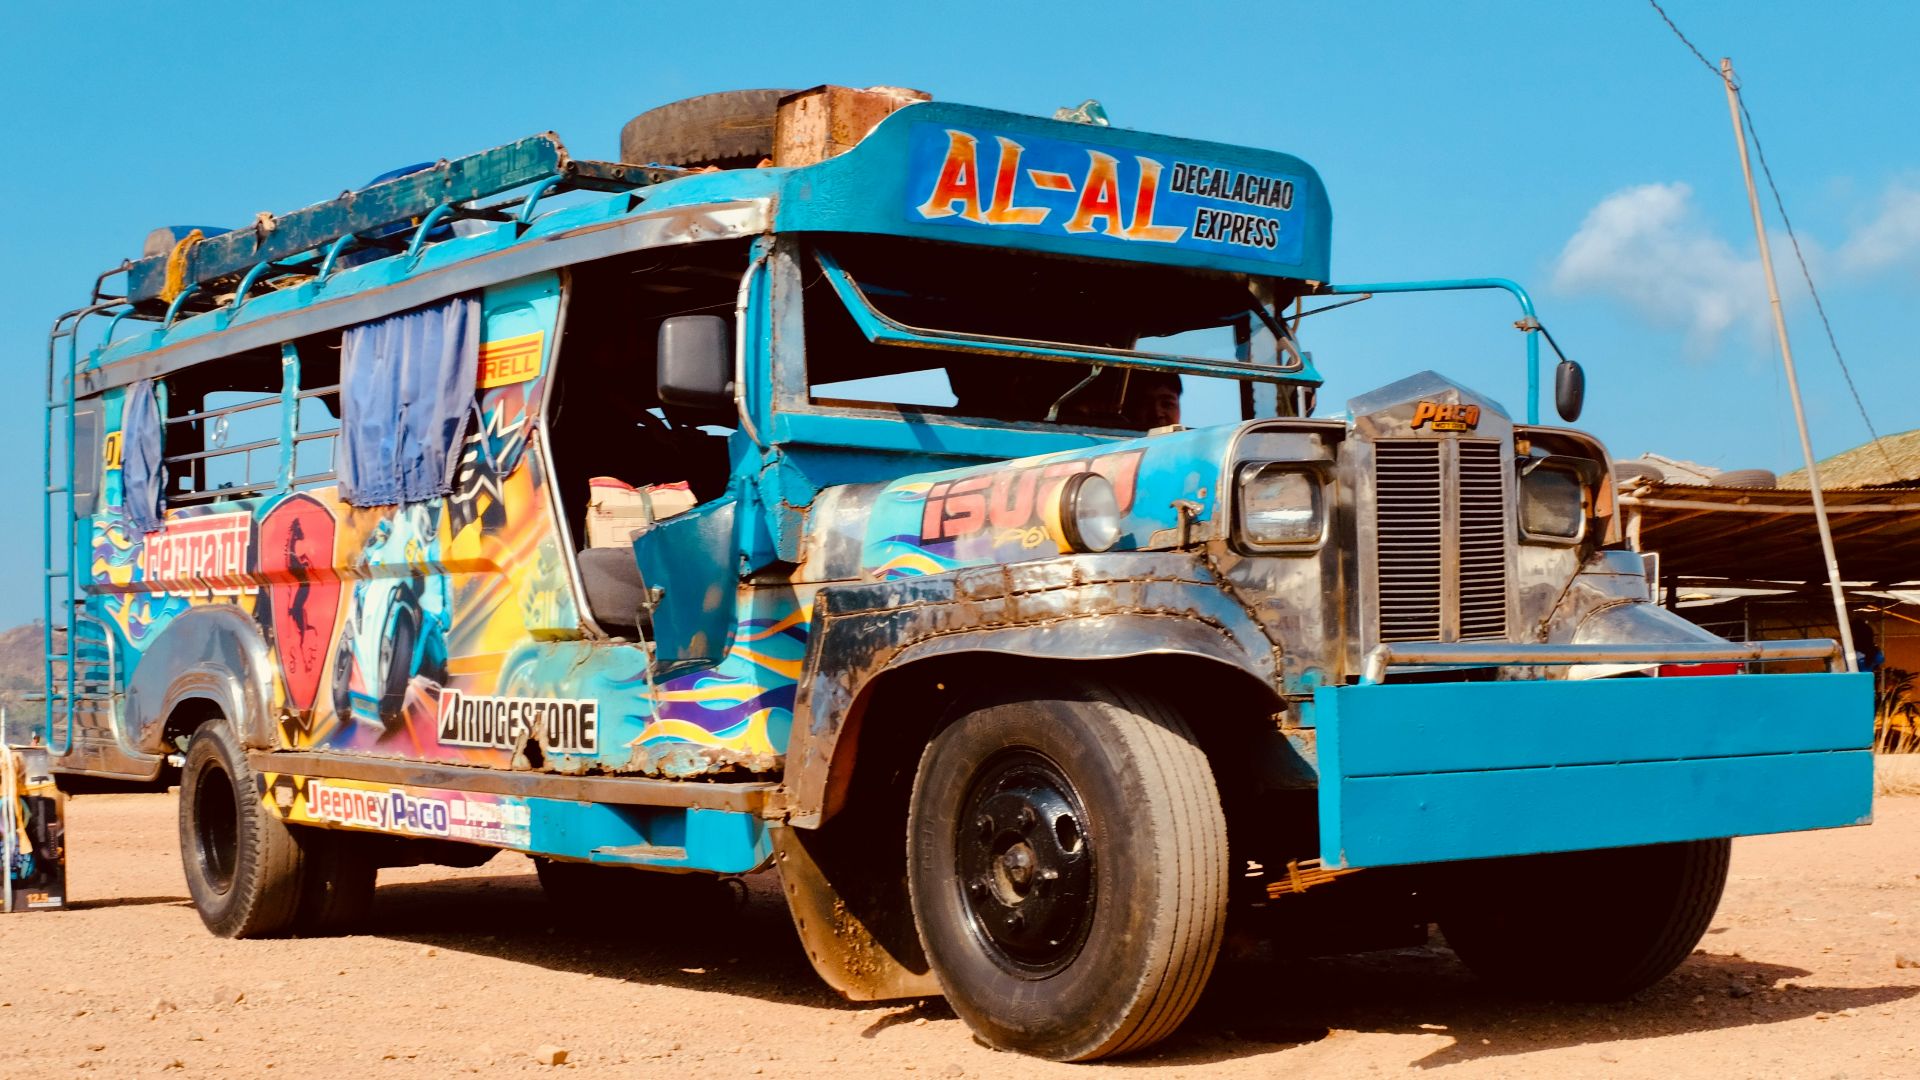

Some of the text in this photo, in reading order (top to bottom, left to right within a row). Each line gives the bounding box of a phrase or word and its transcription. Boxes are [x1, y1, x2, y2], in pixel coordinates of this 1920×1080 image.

[917, 129, 1188, 243] AL-AL
[1170, 163, 1294, 210] DECALACHAO
[1192, 209, 1280, 248] EXPRESS
[478, 355, 534, 380] RELL
